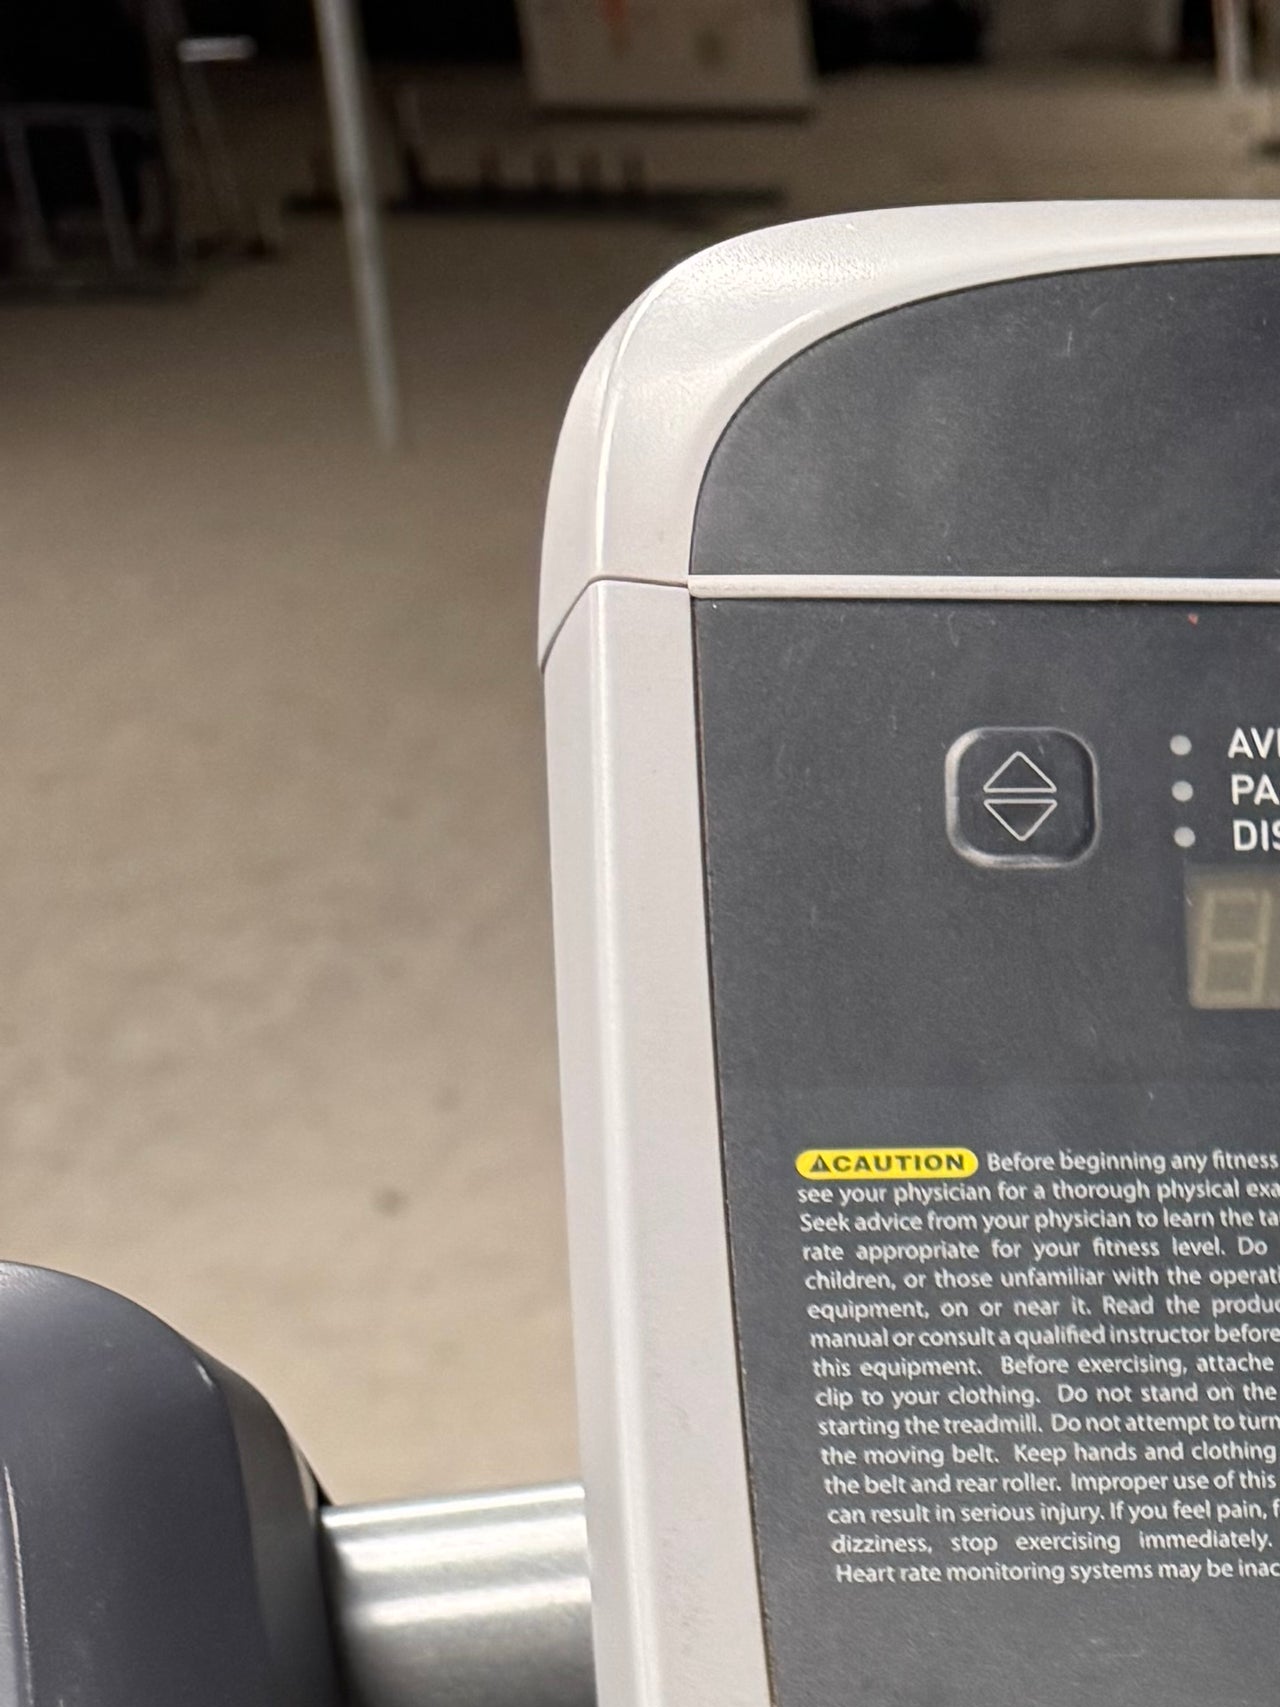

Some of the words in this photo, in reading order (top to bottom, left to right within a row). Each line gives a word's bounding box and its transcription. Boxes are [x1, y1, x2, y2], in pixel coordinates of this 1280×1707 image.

[832, 1154, 965, 1172] CAUTION
[986, 1153, 1055, 1171] Before
[1059, 1152, 1166, 1175] beginning
[1170, 1155, 1209, 1174] any
[1212, 1151, 1279, 1169] fitness
[802, 1244, 844, 1261] rate
[854, 1241, 980, 1264] appropriate
[991, 1240, 1023, 1258] for
[1033, 1243, 1082, 1262] your
[1092, 1239, 1160, 1257] fitness
[1171, 1238, 1226, 1256] level.
[1237, 1237, 1269, 1256] Do
[804, 1271, 896, 1292] children,
[903, 1274, 928, 1288] or
[934, 1270, 994, 1288] those
[1000, 1268, 1106, 1287] unfamiliar
[1112, 1268, 1160, 1286] with
[1167, 1267, 1202, 1285] the
[806, 1300, 929, 1323] equipment,
[940, 1303, 969, 1317] on
[979, 1303, 1004, 1317] or
[1013, 1302, 1061, 1316] near
[1071, 1298, 1091, 1316] it.
[1102, 1297, 1155, 1315] Read
[1166, 1296, 1201, 1314] the
[809, 1329, 890, 1348] manual
[892, 1333, 916, 1347] or
[917, 1328, 996, 1346] consult
[998, 1332, 1011, 1346] a
[1013, 1327, 1107, 1350] qualified
[1109, 1325, 1211, 1344] instructor
[812, 1359, 851, 1377] this
[859, 1358, 982, 1381] equipment.
[1000, 1356, 1070, 1375] Before
[1077, 1355, 1187, 1378] exercising,
[1195, 1354, 1275, 1372] attache
[814, 1388, 854, 1411] clip
[861, 1389, 884, 1406] to
[891, 1391, 941, 1410] your
[947, 1386, 1040, 1409] clothing.
[1057, 1385, 1089, 1403] Do
[1096, 1387, 1133, 1403] not
[1140, 1384, 1199, 1402] stand
[1206, 1387, 1235, 1402] on
[1242, 1383, 1278, 1401] the
[820, 1447, 857, 1465] the
[863, 1446, 945, 1469] moving
[951, 1445, 999, 1463] belt.
[1013, 1444, 1067, 1467] Keep
[1073, 1443, 1137, 1462] hands
[1143, 1442, 1185, 1461] and
[1190, 1441, 1277, 1464] clothing
[824, 1476, 860, 1494] the
[864, 1476, 907, 1494] belt
[909, 1475, 952, 1493] and
[955, 1478, 999, 1493] rear
[1001, 1474, 1061, 1492] roller.
[1070, 1472, 1170, 1496] Improper
[1173, 1476, 1210, 1490] use
[1212, 1471, 1235, 1489] of
[1239, 1471, 1277, 1489] this
[827, 1509, 866, 1524] can
[870, 1505, 931, 1523] result
[934, 1504, 955, 1522] in
[960, 1503, 1035, 1522] serious
[1040, 1502, 1105, 1525] injury.
[1109, 1502, 1125, 1520] If
[1128, 1505, 1168, 1524] you
[1172, 1501, 1212, 1519] feel
[1216, 1500, 1267, 1523] pain,
[830, 1535, 932, 1556] dizziness,
[951, 1536, 998, 1557] stop
[1015, 1532, 1121, 1556] exercising
[1139, 1530, 1272, 1554] immediately.
[835, 1564, 896, 1583] Heart
[899, 1565, 942, 1582] rate
[945, 1562, 1065, 1585] monitoring
[1070, 1563, 1153, 1584] systems
[1158, 1564, 1203, 1583] may
[1206, 1560, 1234, 1578] be
